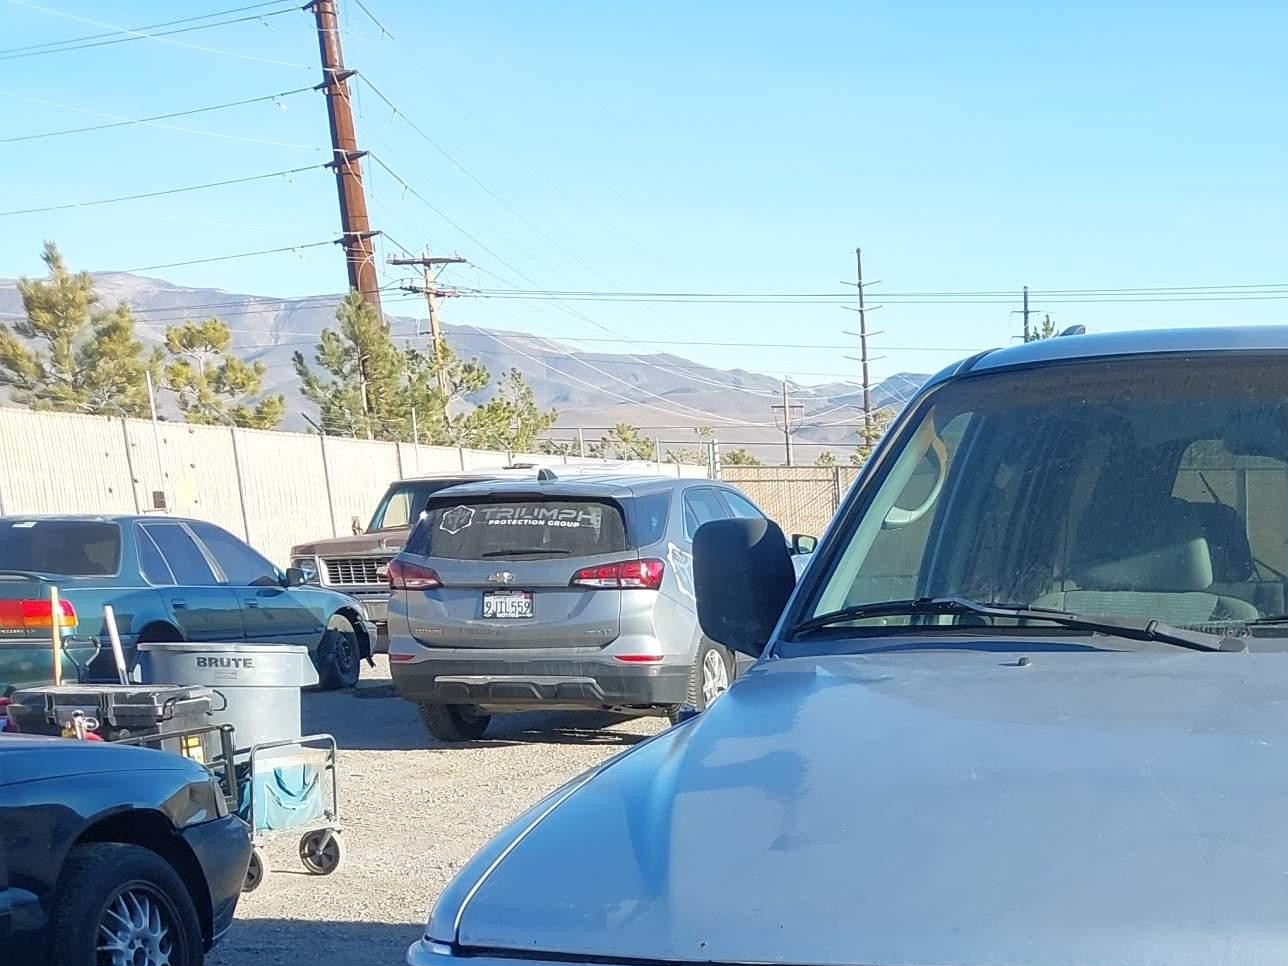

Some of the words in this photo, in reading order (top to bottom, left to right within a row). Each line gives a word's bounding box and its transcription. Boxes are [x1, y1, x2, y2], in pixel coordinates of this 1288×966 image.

[481, 507, 600, 523] TRIUMPH
[547, 520, 581, 528] GROUP
[196, 656, 256, 668] BRUTE
